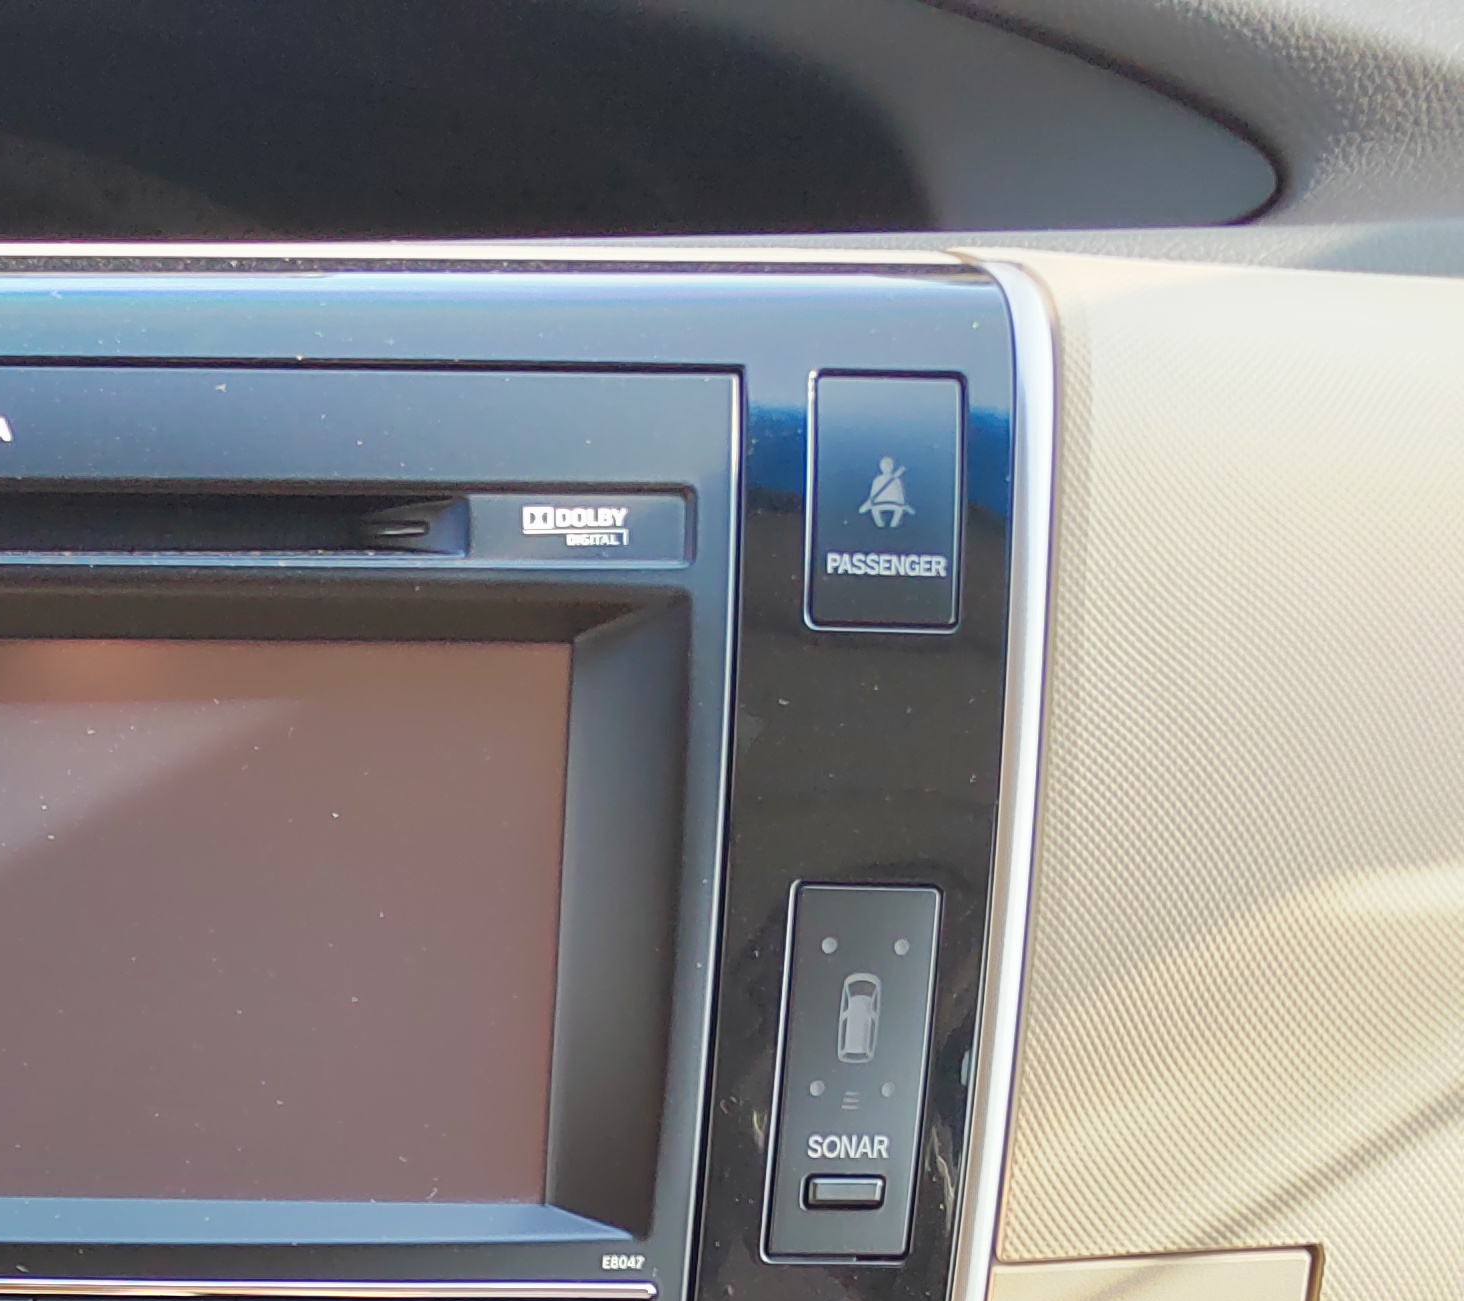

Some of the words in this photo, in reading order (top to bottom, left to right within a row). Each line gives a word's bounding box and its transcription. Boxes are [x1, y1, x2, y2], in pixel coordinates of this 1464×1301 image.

[554, 506, 628, 529] DOLBY
[565, 532, 621, 547] DIGITAL
[826, 551, 947, 578] PASSENGER
[807, 1134, 889, 1159] SONAR
